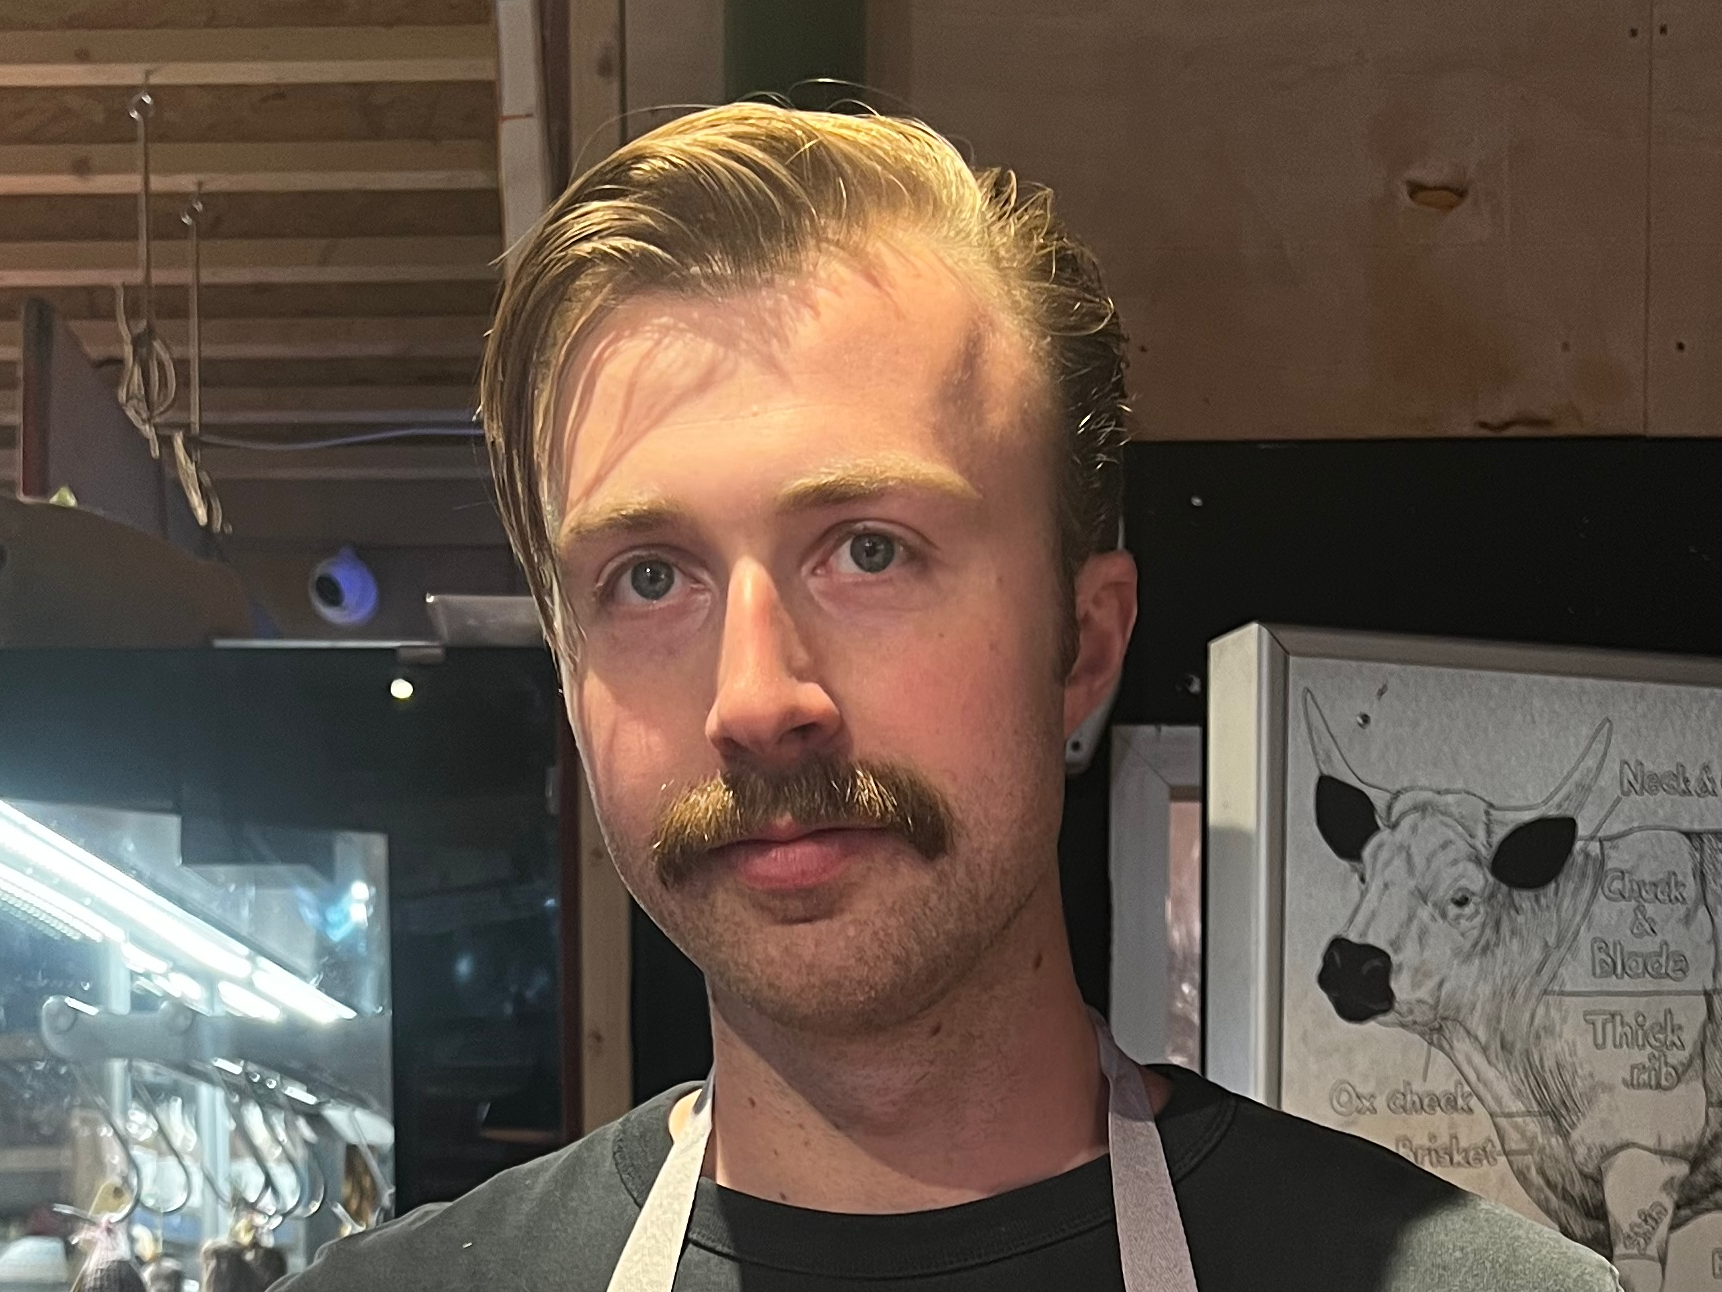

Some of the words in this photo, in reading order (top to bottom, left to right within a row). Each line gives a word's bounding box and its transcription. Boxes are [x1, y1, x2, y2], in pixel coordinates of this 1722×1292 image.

[1619, 759, 1694, 797] Neck
[1601, 867, 1688, 905] Chuck
[1630, 904, 1657, 938] &
[1591, 937, 1690, 982] Blade
[1583, 1008, 1686, 1051] Thick
[1629, 1051, 1681, 1091] rib
[1329, 1079, 1378, 1117] Ox
[1386, 1079, 1475, 1115] cheek
